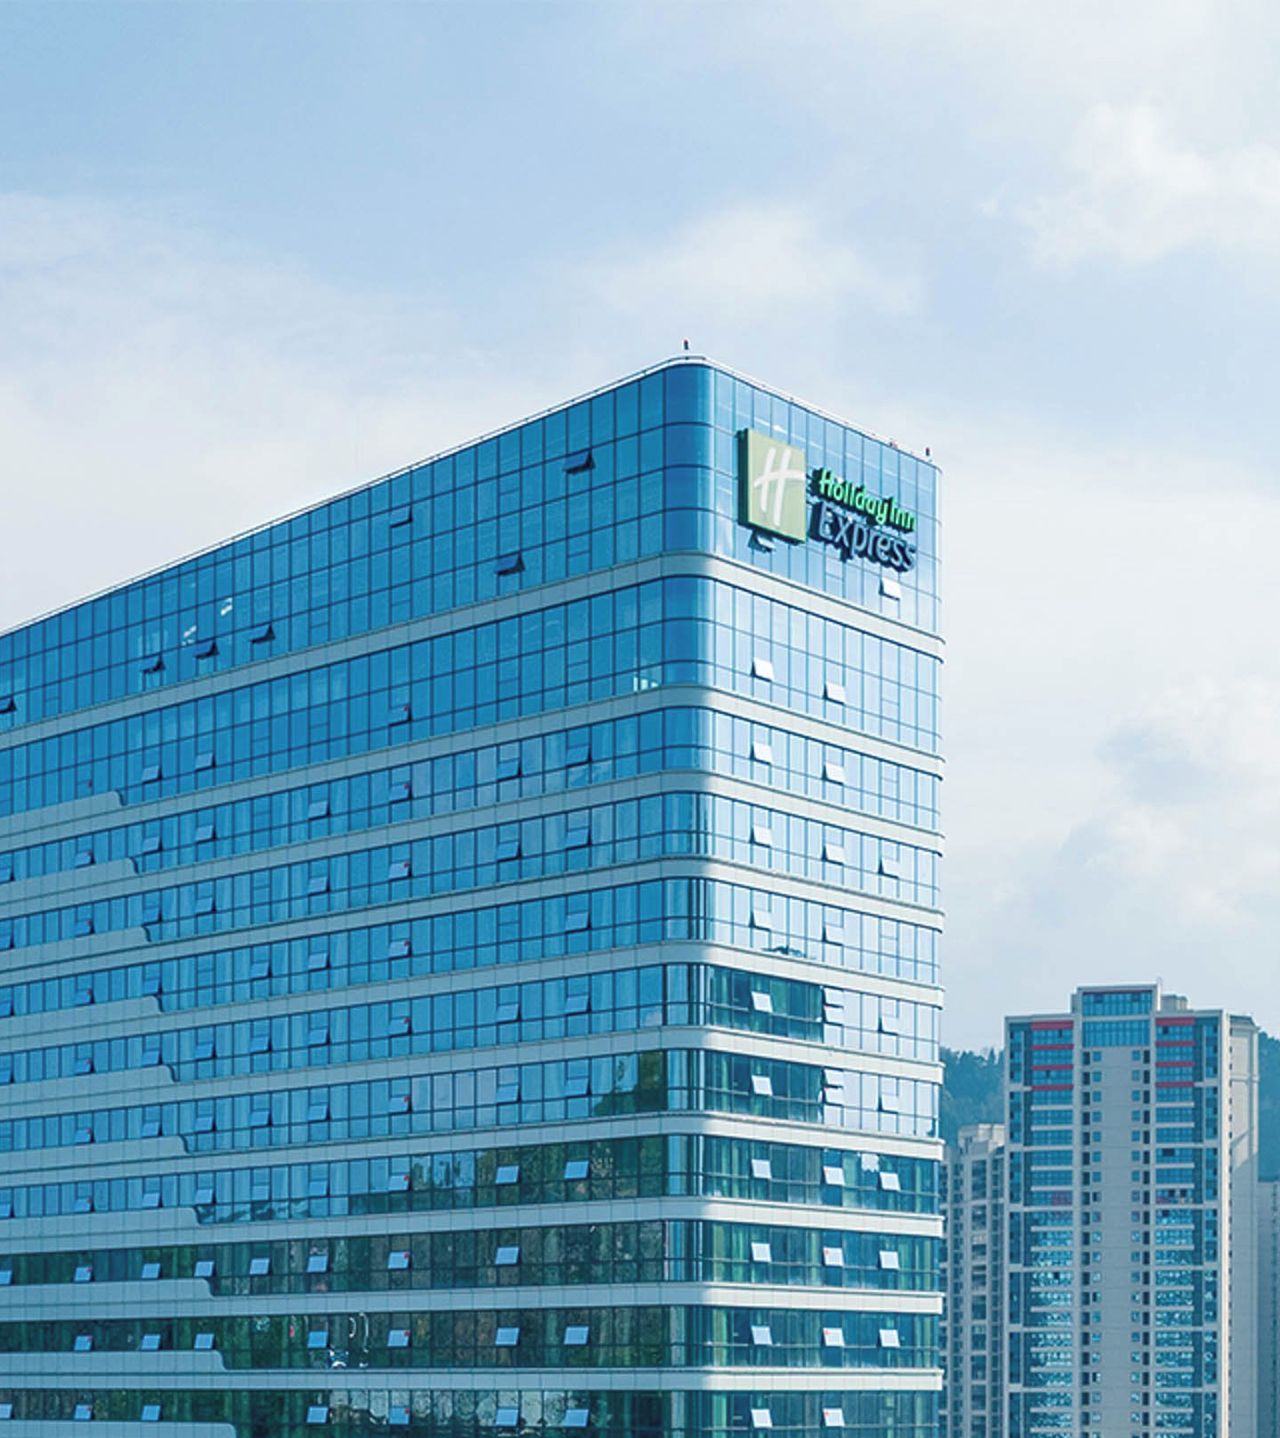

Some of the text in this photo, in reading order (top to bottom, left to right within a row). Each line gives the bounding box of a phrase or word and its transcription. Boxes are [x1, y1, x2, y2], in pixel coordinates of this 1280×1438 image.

[819, 468, 916, 533] Holiday Inn
[819, 503, 917, 573] Express
